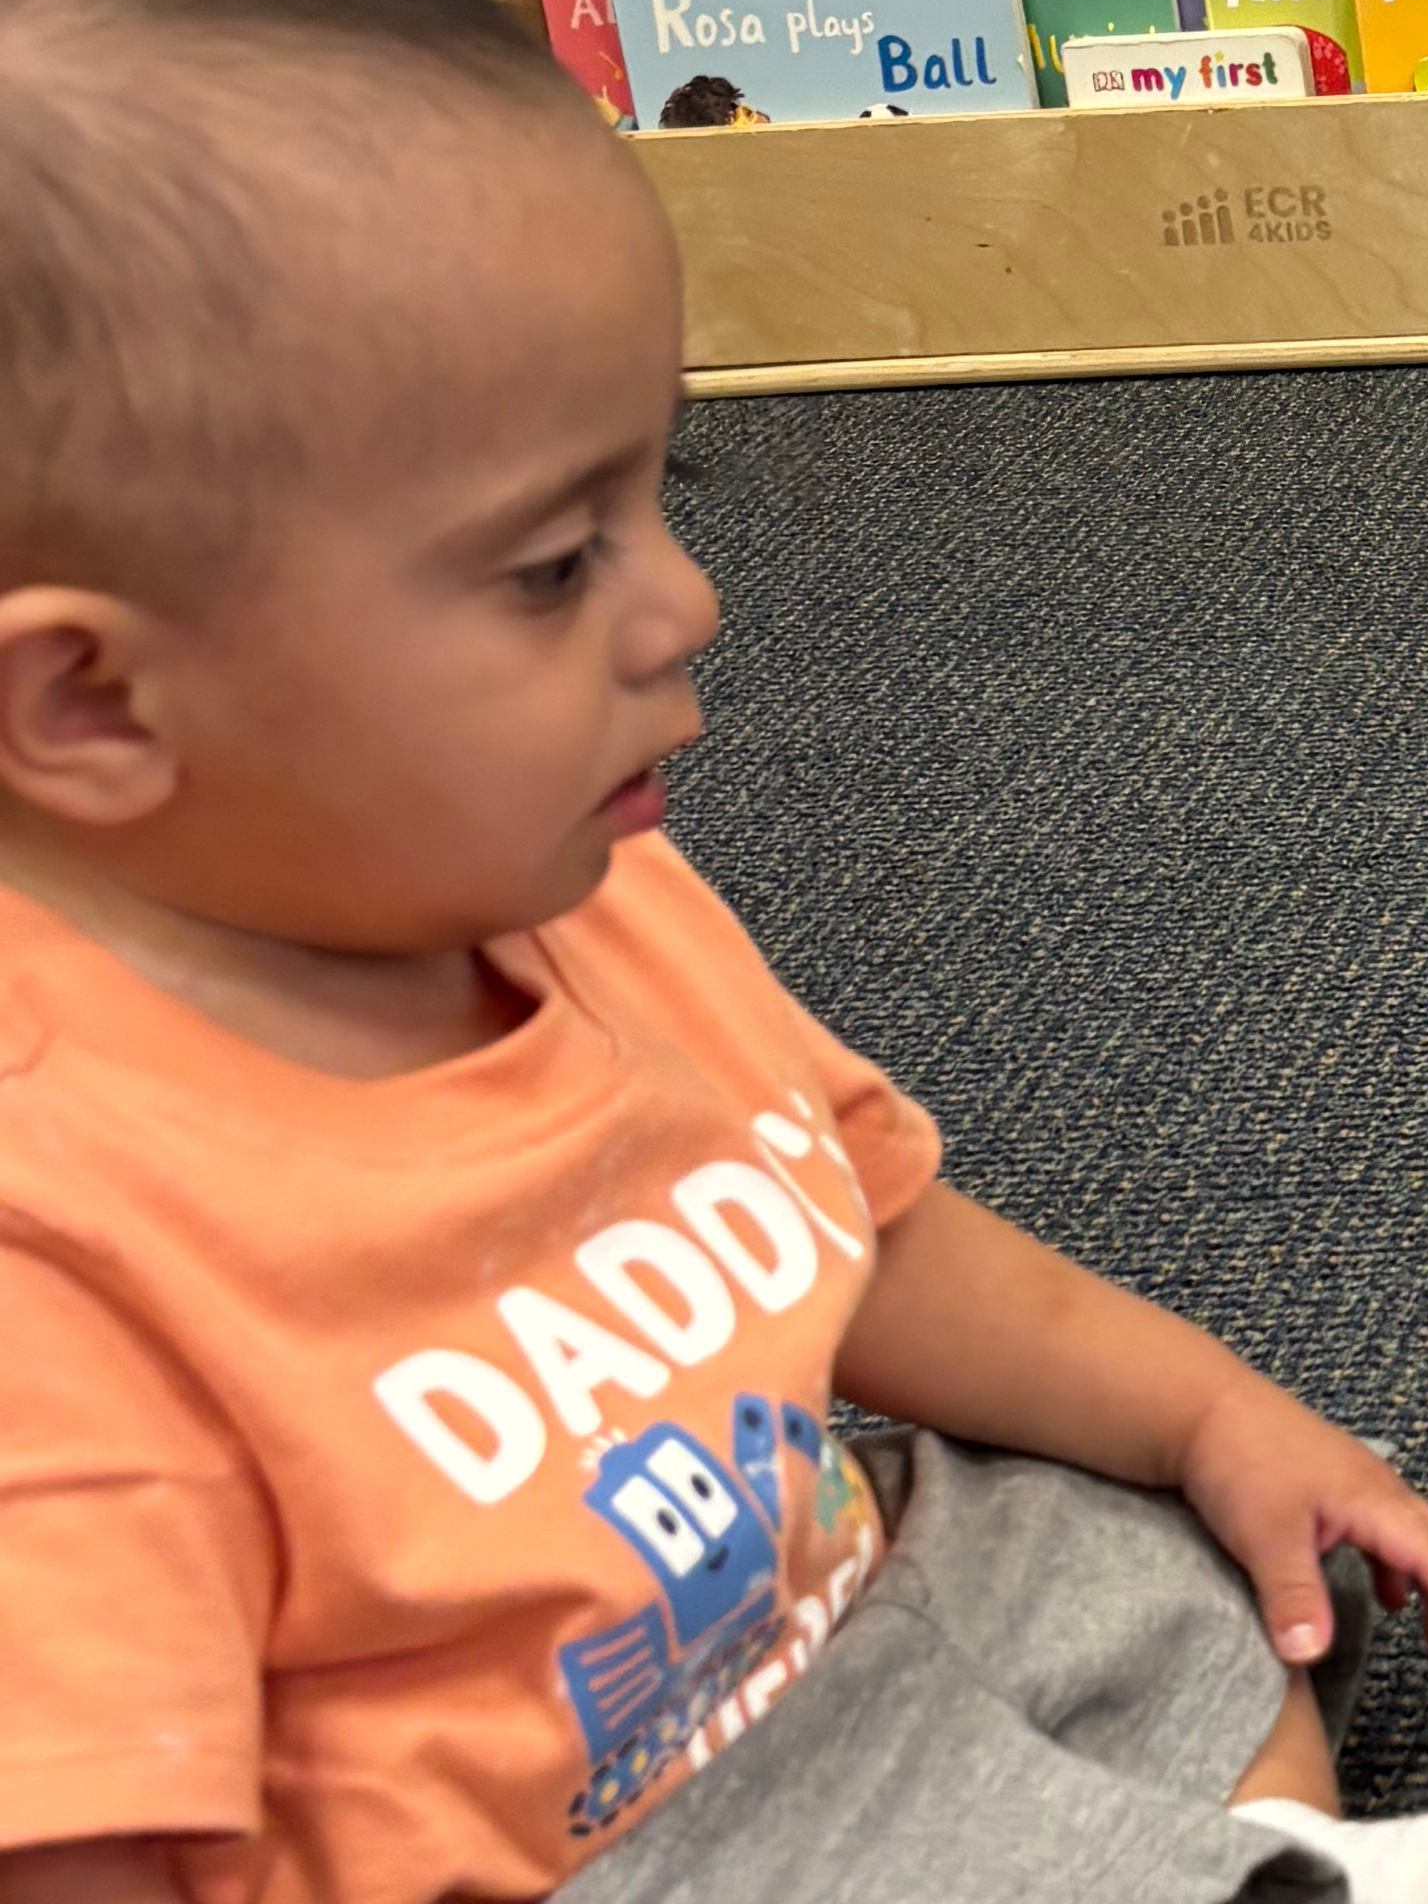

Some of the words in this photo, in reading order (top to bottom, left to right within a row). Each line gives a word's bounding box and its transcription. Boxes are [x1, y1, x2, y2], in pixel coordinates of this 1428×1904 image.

[877, 34, 998, 94] Ball
[1131, 64, 1187, 101] my
[1198, 50, 1279, 89] first
[1244, 184, 1327, 218] ECR
[1247, 220, 1332, 243] 4KIDS
[372, 1090, 866, 1505] DADDY
